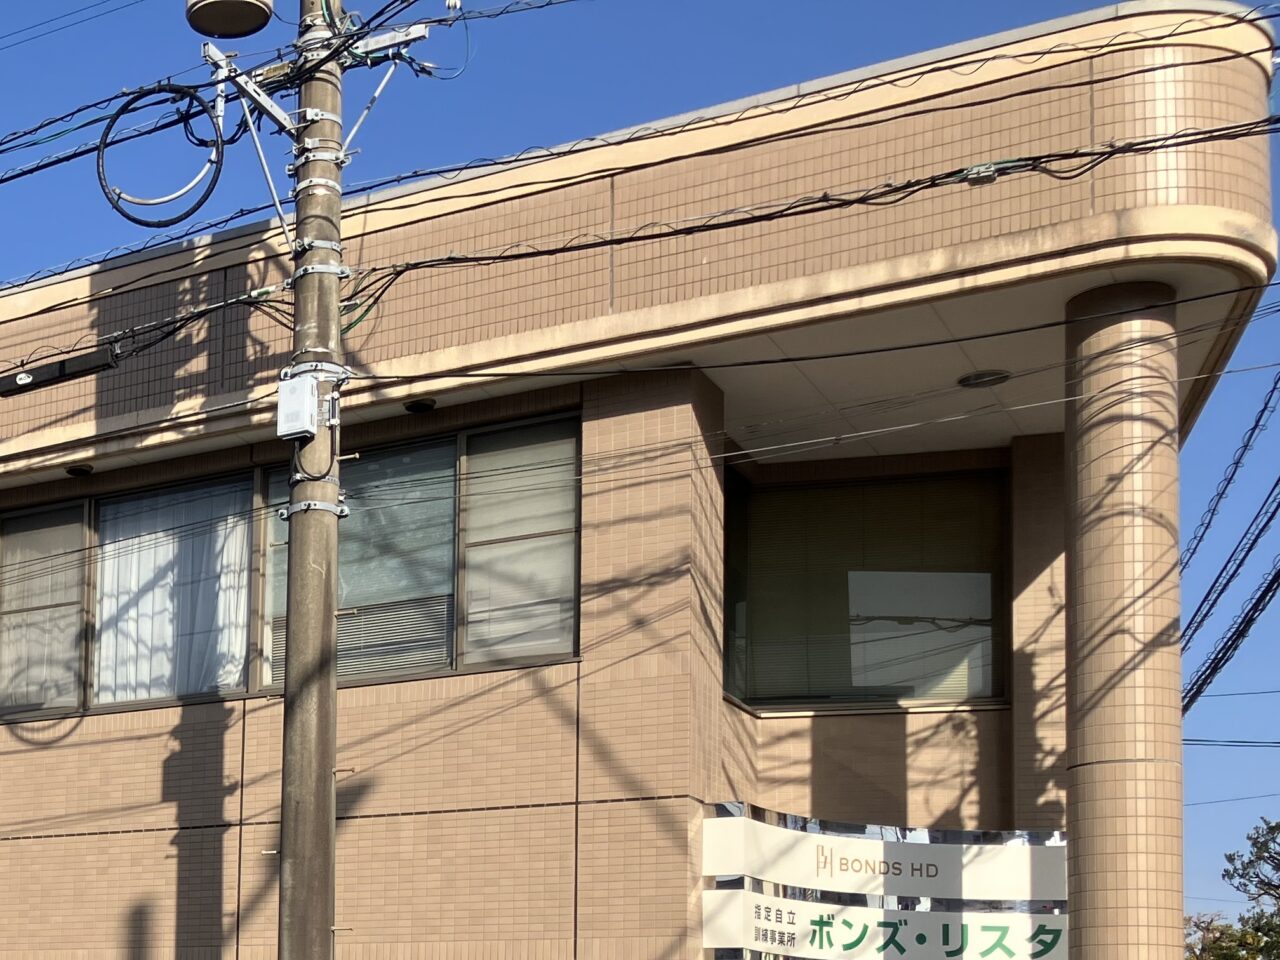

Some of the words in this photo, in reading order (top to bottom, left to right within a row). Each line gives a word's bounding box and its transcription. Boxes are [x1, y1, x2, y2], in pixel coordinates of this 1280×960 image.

[839, 857, 902, 876] BONDS
[910, 862, 939, 878] HD
[754, 904, 796, 925] 指定自立
[809, 914, 1063, 960] ボンズ・リスタ
